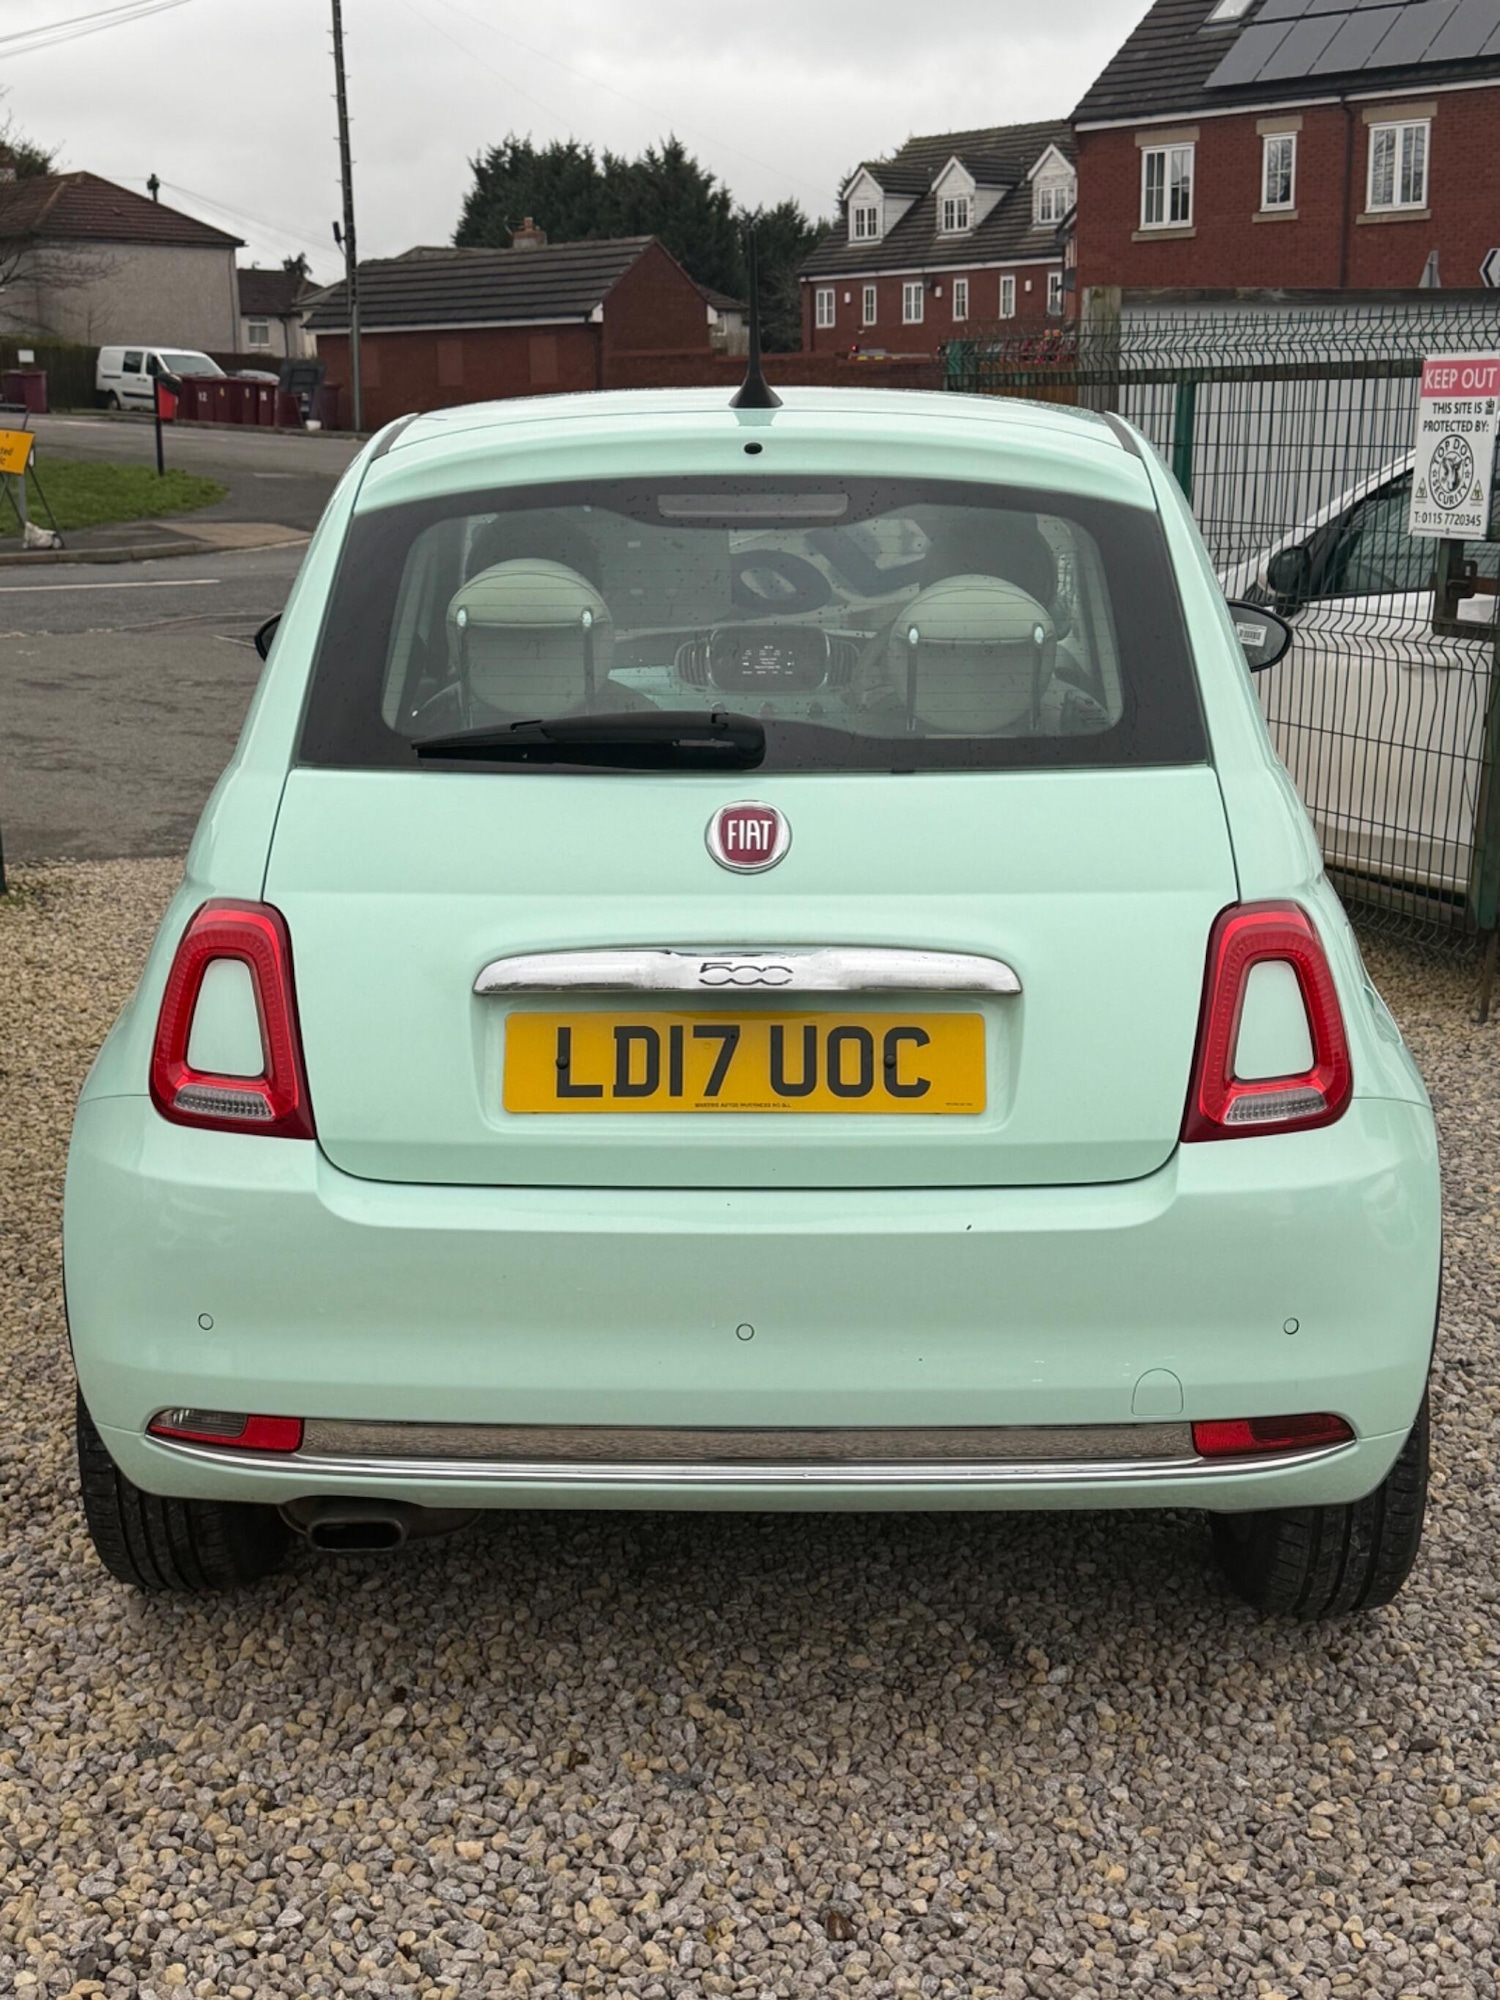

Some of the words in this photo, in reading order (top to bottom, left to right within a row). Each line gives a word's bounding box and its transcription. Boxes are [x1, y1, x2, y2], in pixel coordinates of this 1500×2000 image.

[1424, 368, 1458, 390] KEEP
[1461, 367, 1498, 389] OUT
[1432, 402, 1452, 415] THIS
[1454, 402, 1472, 414] SITE
[1474, 401, 1483, 414] IS
[1422, 420, 1473, 433] PROTECTED
[1475, 420, 1489, 432] BY:
[1432, 440, 1450, 464] TOP
[1453, 438, 1472, 468] DOG
[1433, 479, 1467, 506] SECURITY
[1444, 513, 1481, 526] 7720345
[727, 819, 773, 851] FIAT
[699, 961, 794, 986] 500
[556, 1025, 741, 1098] LD17
[769, 1025, 931, 1098] UOC
